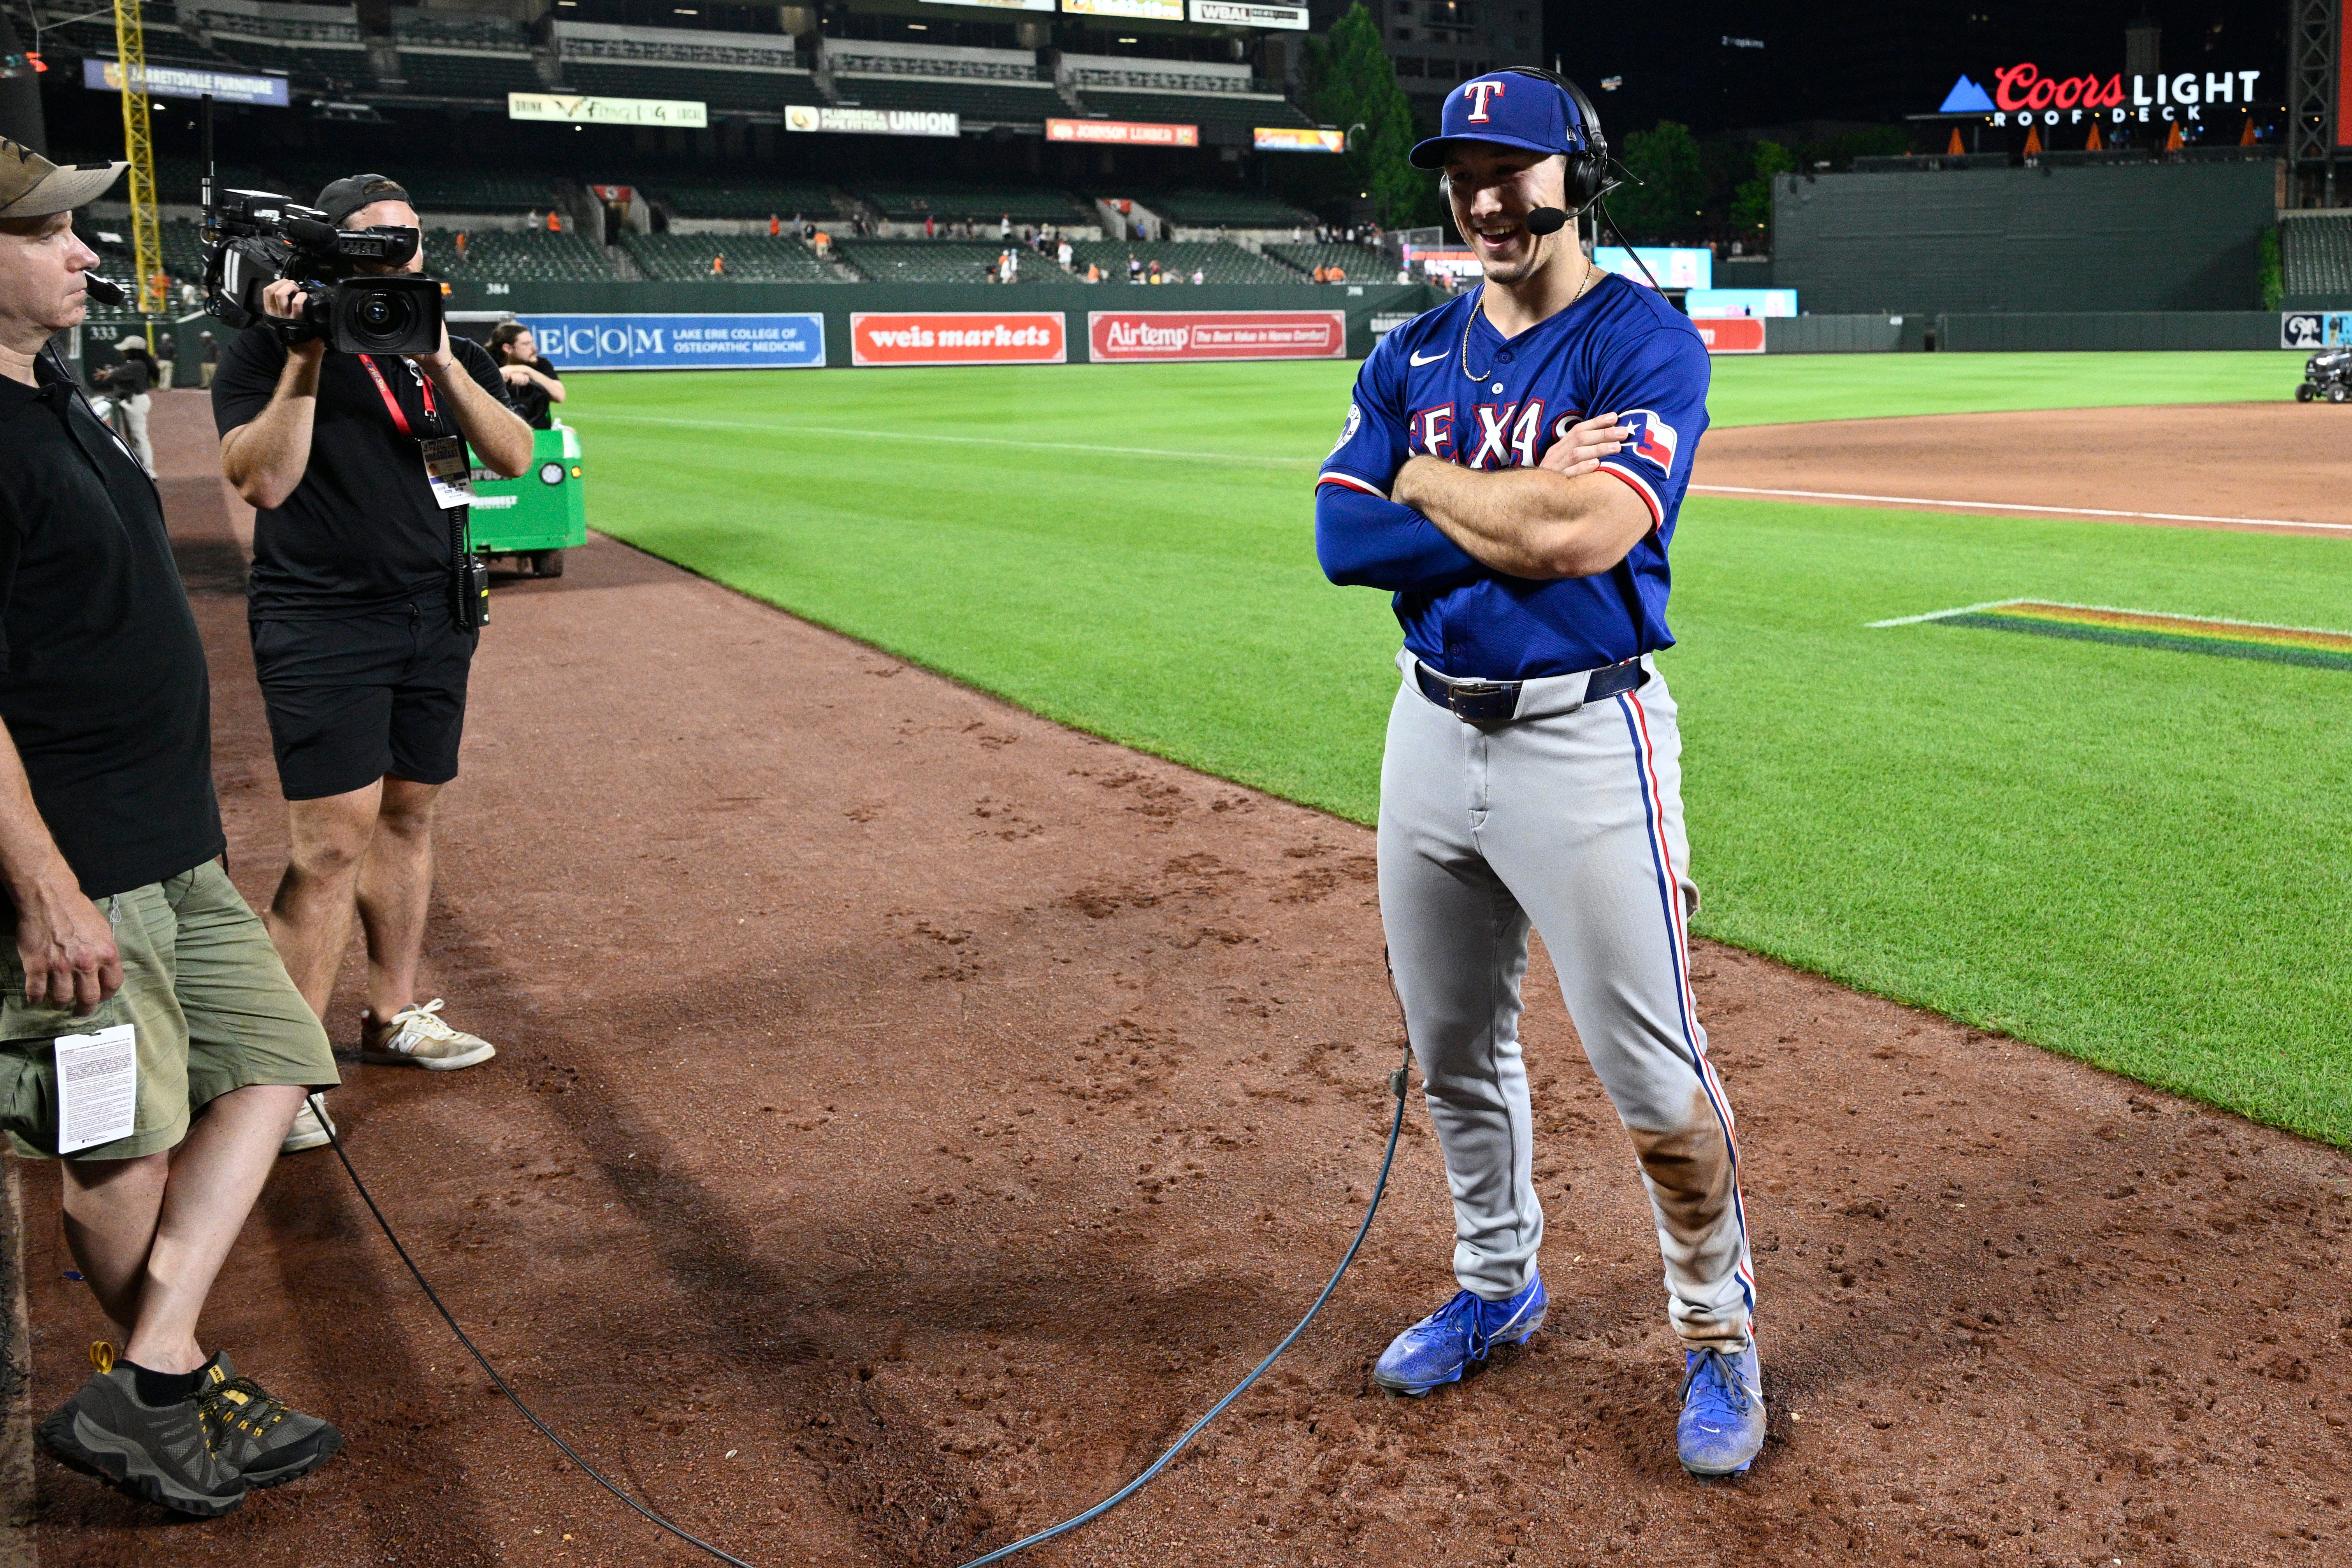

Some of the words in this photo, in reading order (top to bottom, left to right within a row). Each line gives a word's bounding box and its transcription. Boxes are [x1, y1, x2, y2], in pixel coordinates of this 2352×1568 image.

[1202, 5, 1249, 21] WBAL
[1995, 62, 2125, 111] Coors
[2133, 71, 2260, 105] LIGHT
[1464, 81, 1505, 123] T
[890, 111, 956, 133] UNION
[1994, 109, 2083, 126] ROOF
[2112, 105, 2200, 123] DECK
[90, 326, 118, 341] 333
[673, 328, 702, 340] LAKE
[704, 328, 729, 340] ERIE
[731, 328, 779, 340] COLLEGE
[782, 328, 797, 339] OF
[869, 325, 935, 348] weis
[937, 323, 1050, 347] markets
[1107, 321, 1189, 350] Airtemp
[674, 341, 751, 353] OSTEOPATHIC
[752, 341, 806, 353] MEDICINE
